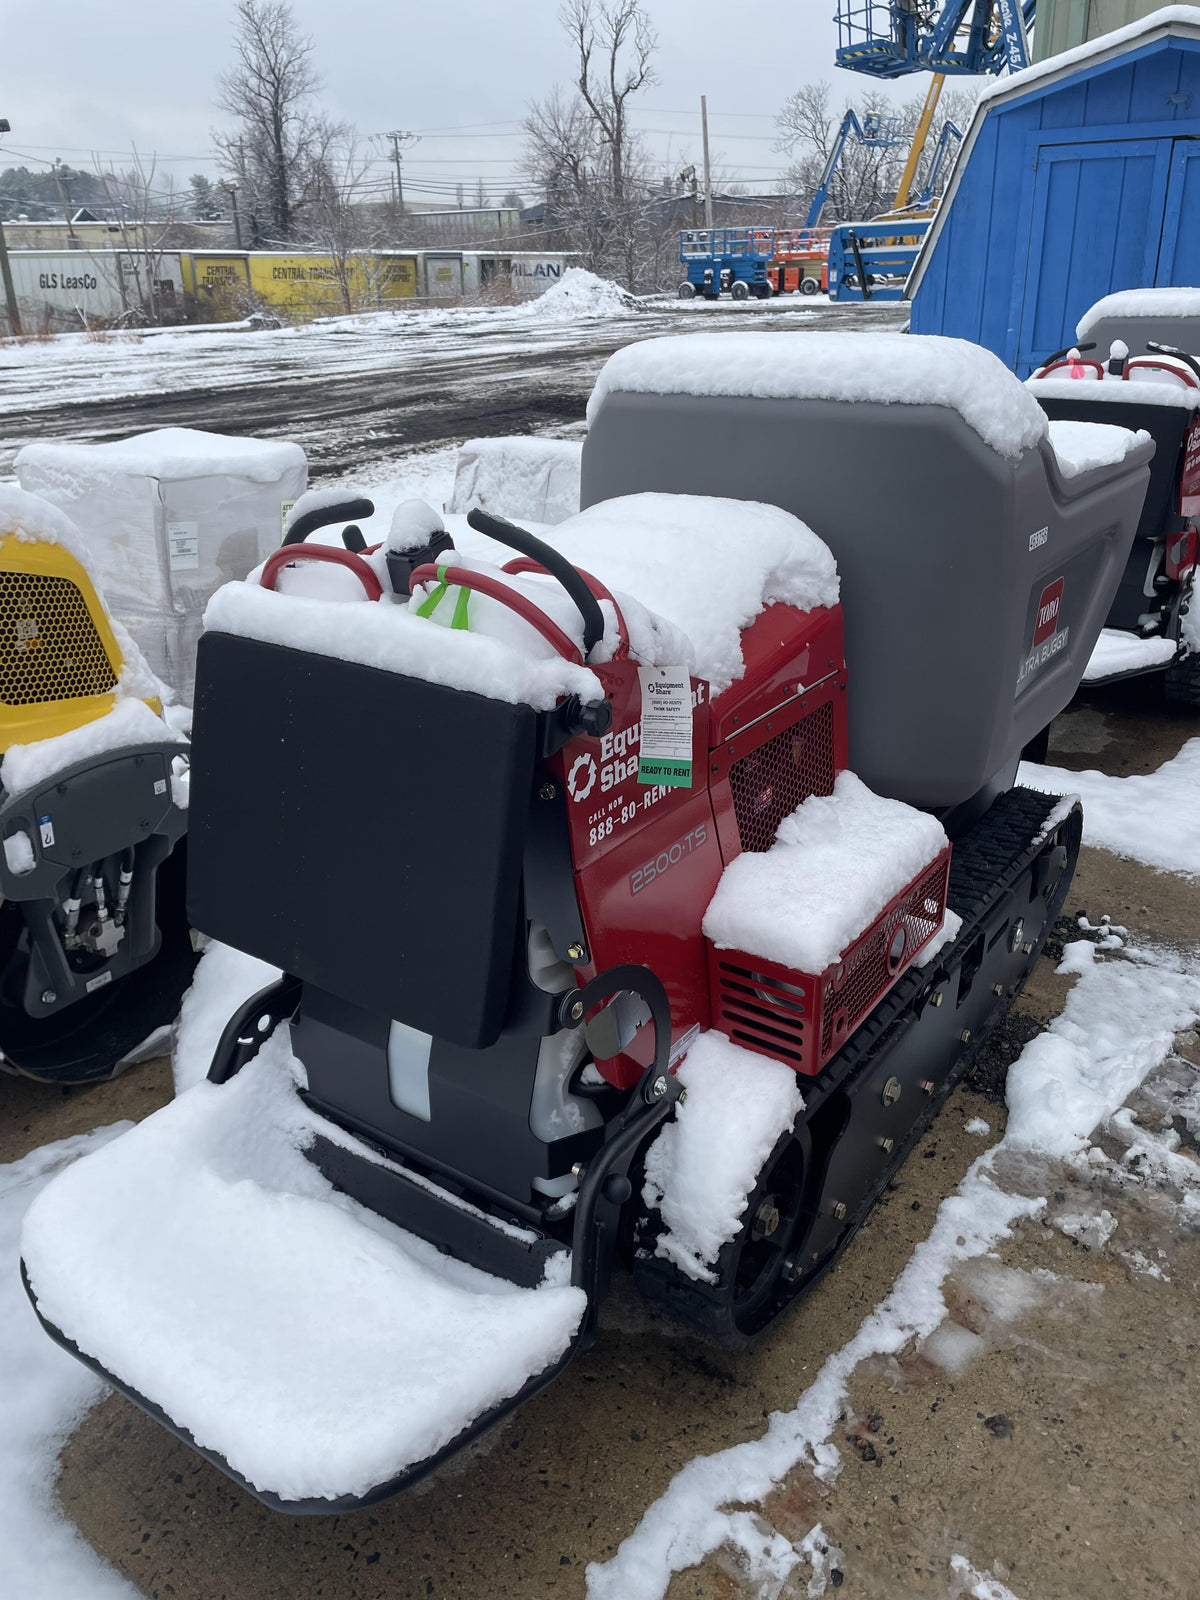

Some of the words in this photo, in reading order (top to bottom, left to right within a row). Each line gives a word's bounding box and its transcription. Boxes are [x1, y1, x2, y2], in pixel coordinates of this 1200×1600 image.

[1000, 0, 1012, 29] enie
[39, 273, 58, 289] GLS
[60, 273, 97, 290] LeasCo
[272, 266, 306, 280] CENTRAL
[1038, 596, 1060, 628] TORO
[1041, 629, 1070, 662] BUGGY
[655, 682, 684, 690] Equipment
[641, 765, 662, 775] READY
[664, 767, 672, 776] TO
[673, 768, 690, 777] RENT
[588, 807, 606, 825] CALL
[608, 795, 624, 812] NOW
